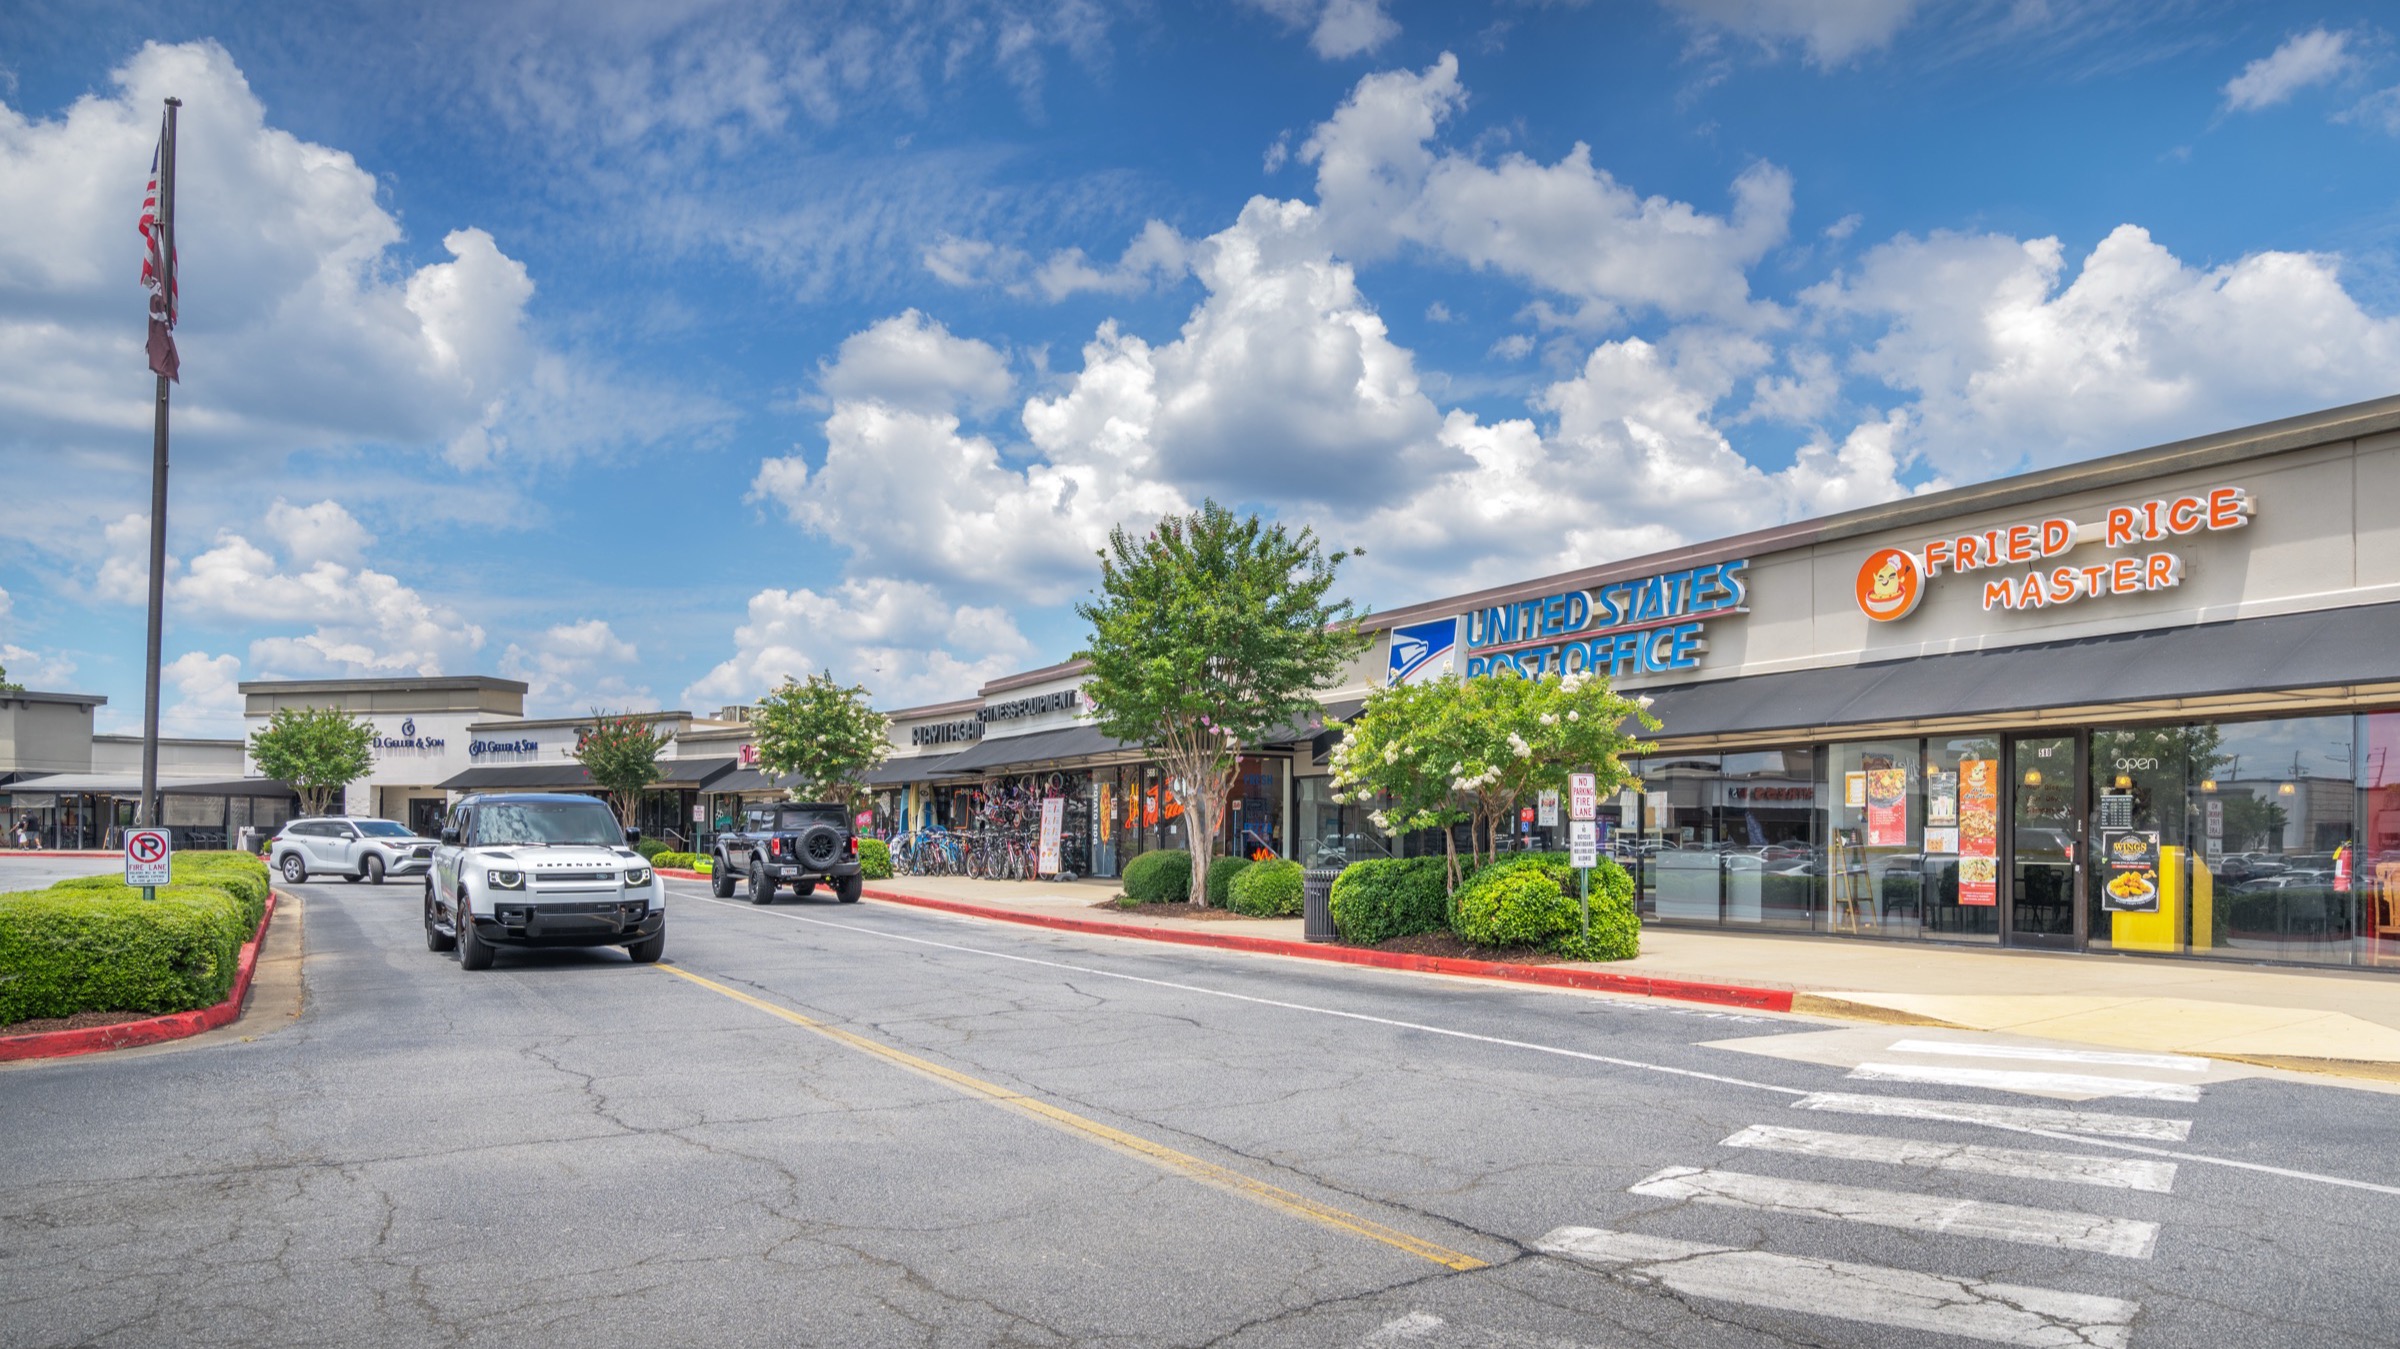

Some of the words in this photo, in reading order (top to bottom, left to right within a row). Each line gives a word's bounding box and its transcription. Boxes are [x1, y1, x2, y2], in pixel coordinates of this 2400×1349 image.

[1924, 518, 2077, 577] FRIED
[2106, 487, 2248, 548] RICE
[1983, 553, 2181, 610] MASTER
[1466, 590, 1593, 648] UNITED
[1600, 560, 1747, 628] STATES
[1467, 646, 1559, 683] POST
[1559, 622, 1703, 678] OFFICE
[983, 701, 1016, 722] FITNESS
[1018, 690, 1077, 716] EQUIPMENT
[912, 726, 938, 746] PLAY
[939, 722, 951, 744] IT
[373, 738, 384, 748] D.
[384, 738, 415, 748] GELLER
[416, 738, 425, 749] &
[425, 736, 445, 748] SON
[488, 741, 514, 753] GELLER
[514, 740, 522, 754] &
[522, 739, 538, 751] SON
[2116, 757, 2158, 773] open
[1578, 777, 1587, 786] NO
[1573, 788, 1593, 796] PARKING
[1576, 797, 1590, 806] FIRE
[1575, 808, 1592, 816] LANE
[2113, 842, 2147, 852] WINGS
